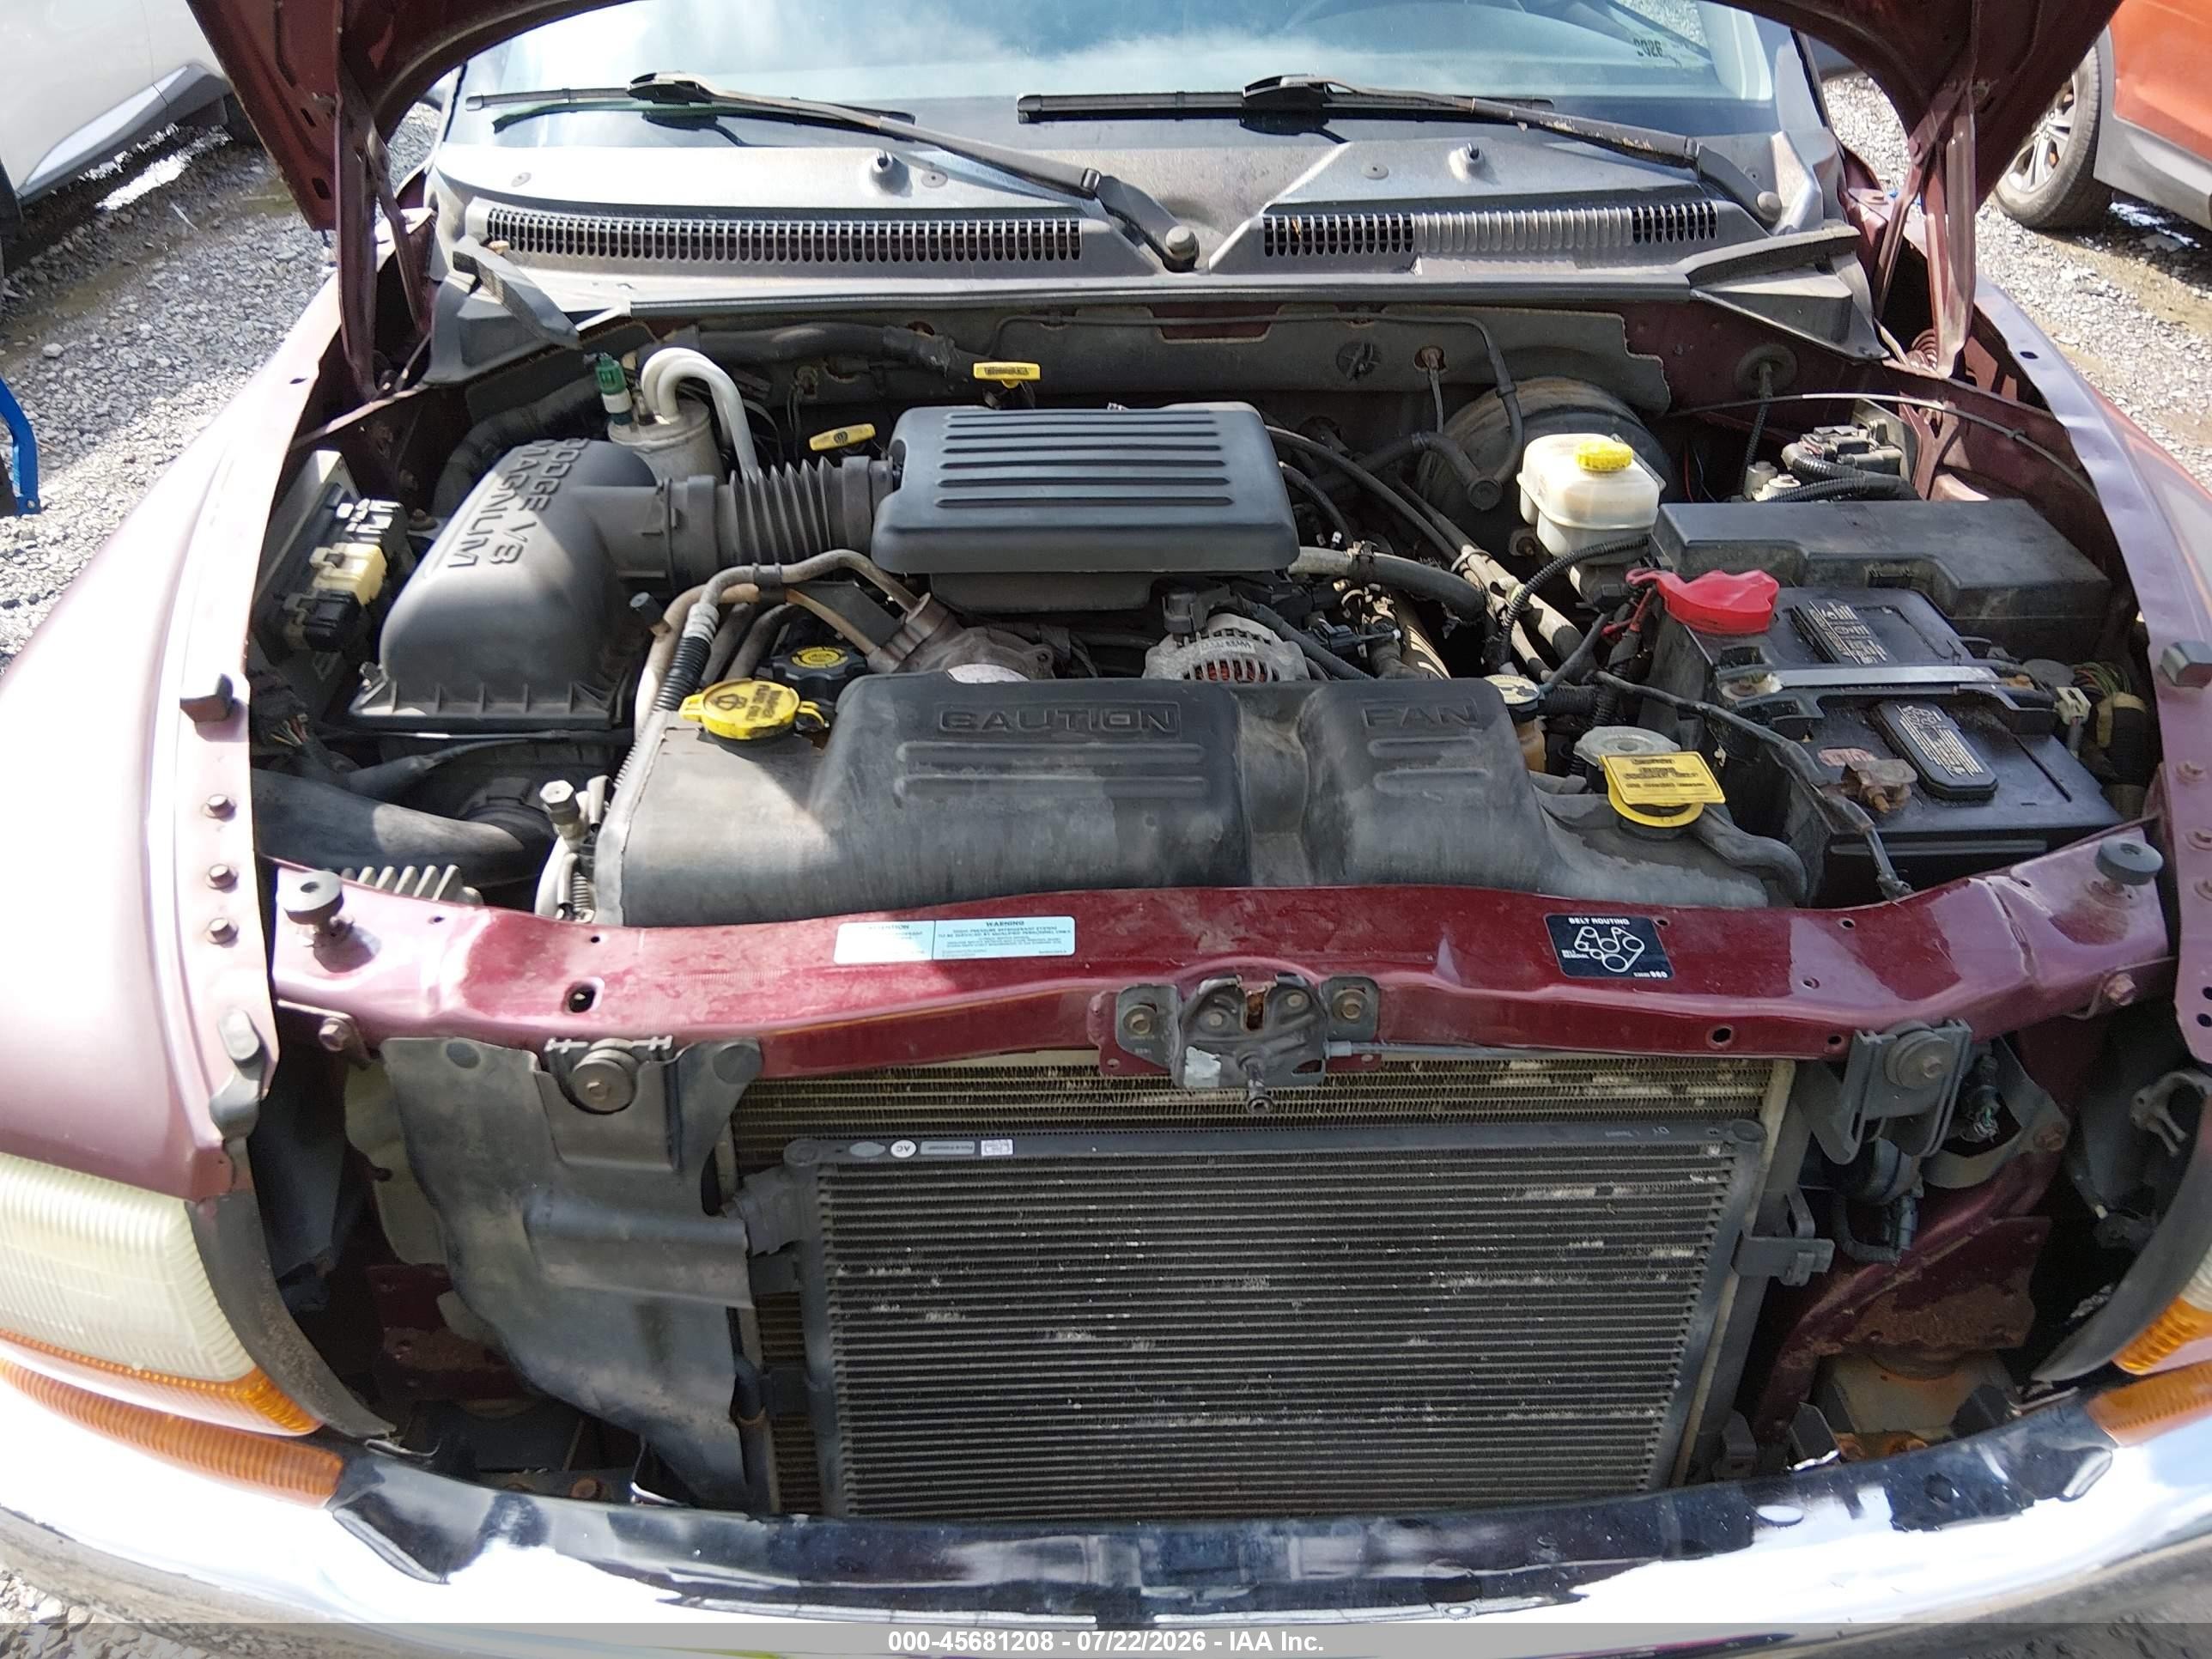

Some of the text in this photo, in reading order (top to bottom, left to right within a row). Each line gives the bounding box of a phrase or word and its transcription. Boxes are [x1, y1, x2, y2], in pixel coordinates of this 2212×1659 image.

[447, 439, 558, 568] MAGNUM
[489, 437, 591, 565] DODGE V8
[939, 708, 1171, 733] CAUTION
[1359, 706, 1480, 730] FAN
